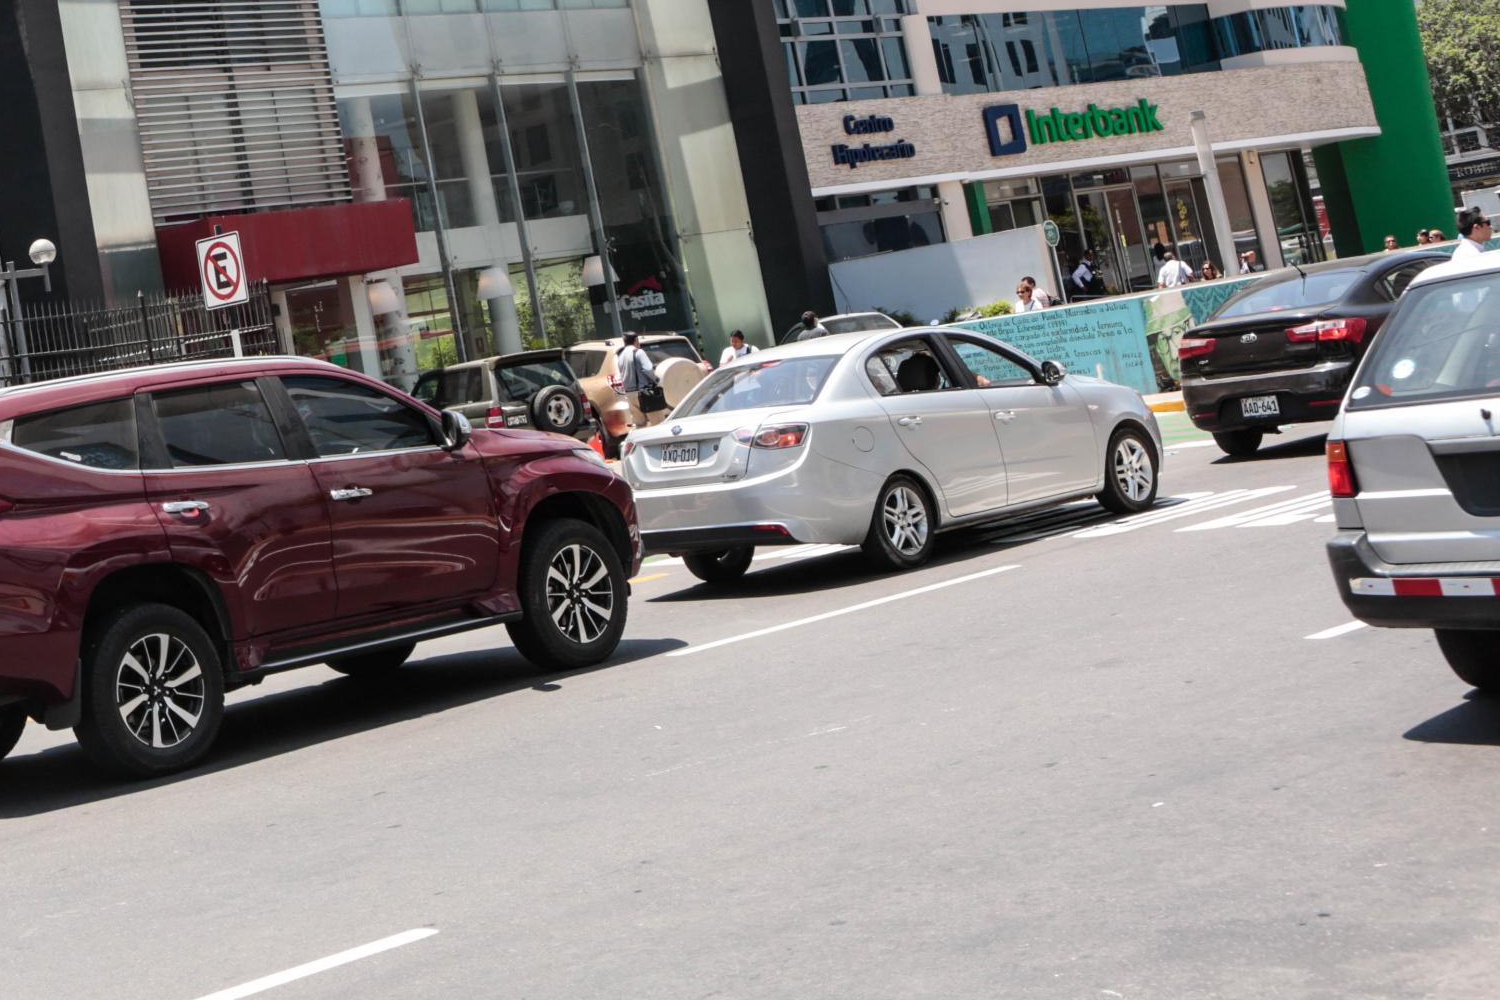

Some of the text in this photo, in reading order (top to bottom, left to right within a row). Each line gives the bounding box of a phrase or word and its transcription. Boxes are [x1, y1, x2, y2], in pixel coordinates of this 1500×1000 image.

[843, 114, 895, 136] Centro
[1025, 98, 1164, 145] Interbank
[831, 139, 916, 169] Hipotecario
[1243, 400, 1278, 415] AAD-641
